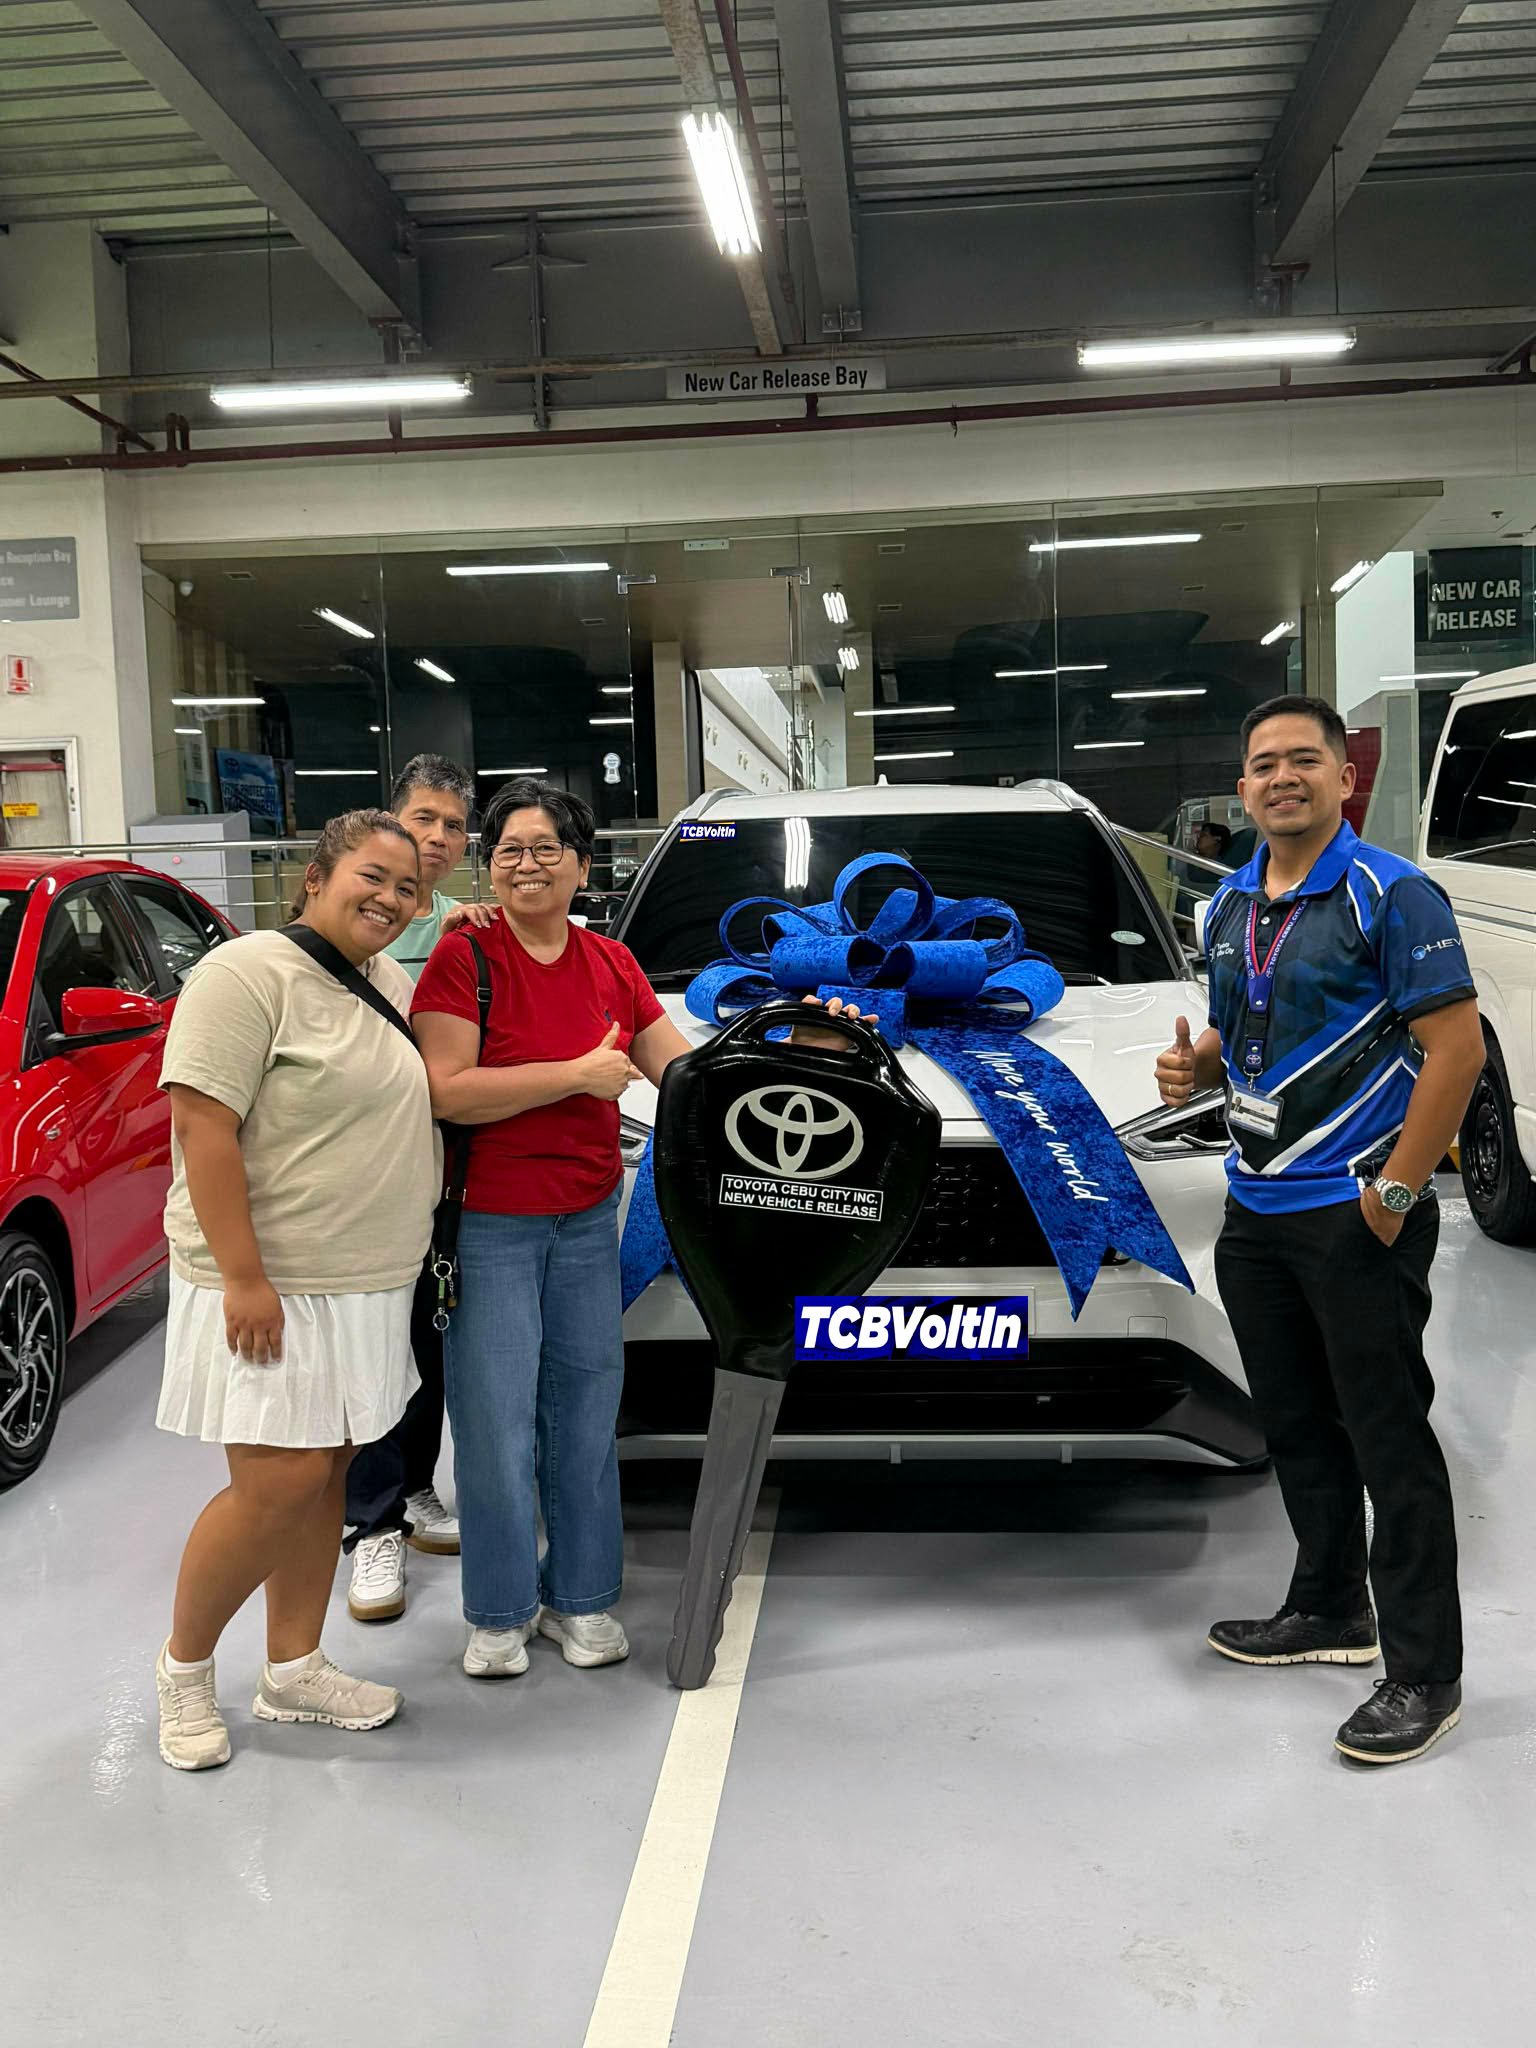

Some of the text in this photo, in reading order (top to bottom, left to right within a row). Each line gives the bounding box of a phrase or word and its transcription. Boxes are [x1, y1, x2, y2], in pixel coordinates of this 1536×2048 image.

[685, 366, 868, 392] New Car Release Bay
[29, 593, 71, 608] Lounge
[1431, 580, 1521, 602] NEW CAR
[1436, 609, 1517, 631] RELEASE
[962, 1050, 1110, 1202] Move your world
[725, 1177, 878, 1205] TOYOTA CEBU CITY INC.
[724, 1191, 878, 1218] NEW VEHICLE RELEASE
